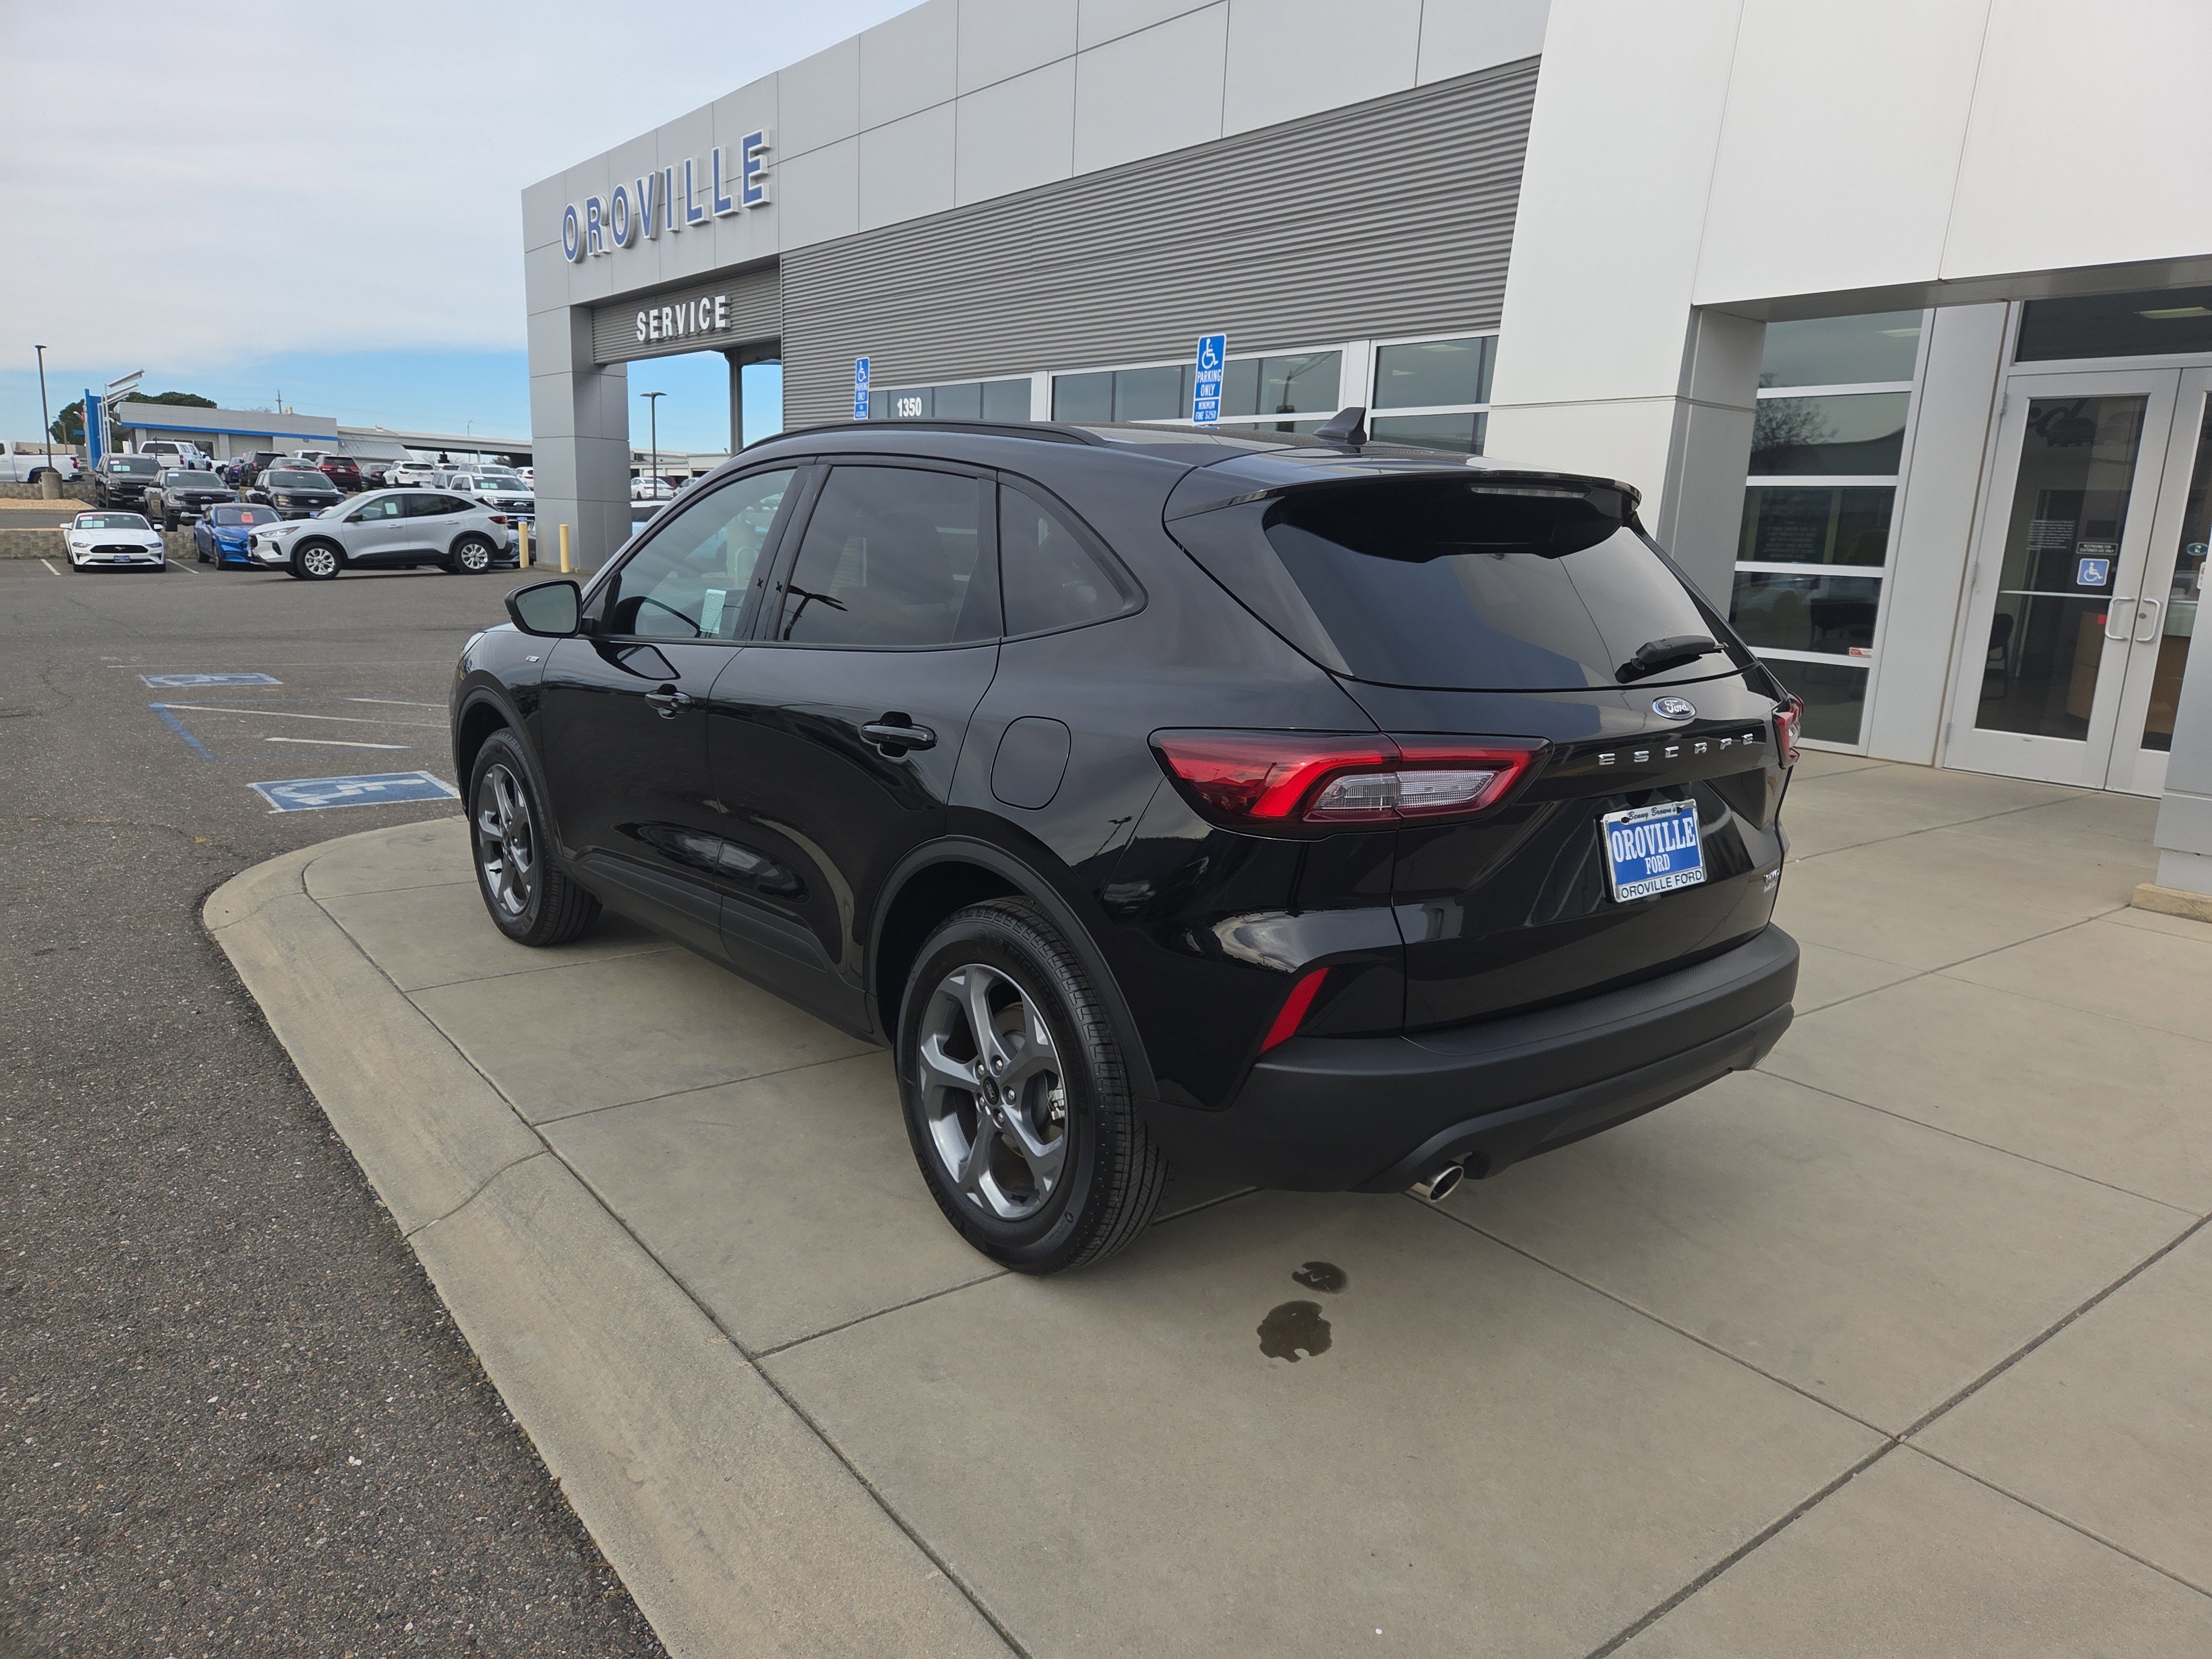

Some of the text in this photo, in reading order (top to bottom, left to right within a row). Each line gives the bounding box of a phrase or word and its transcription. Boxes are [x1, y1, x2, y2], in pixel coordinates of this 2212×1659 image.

[561, 128, 771, 263] OROVILLE
[636, 294, 729, 343] SERVICE
[1197, 369, 1222, 383] PARKING
[1200, 384, 1216, 397] ONLY
[897, 397, 922, 417] 1350
[1663, 699, 1690, 714] Ford
[1598, 733, 1754, 766] ESCAPE
[1627, 804, 1676, 821] Benny Brown's
[1612, 817, 1696, 863] OROVILLE
[1644, 854, 1671, 875] FORD
[1621, 870, 1702, 899] OROVILLE FORD
